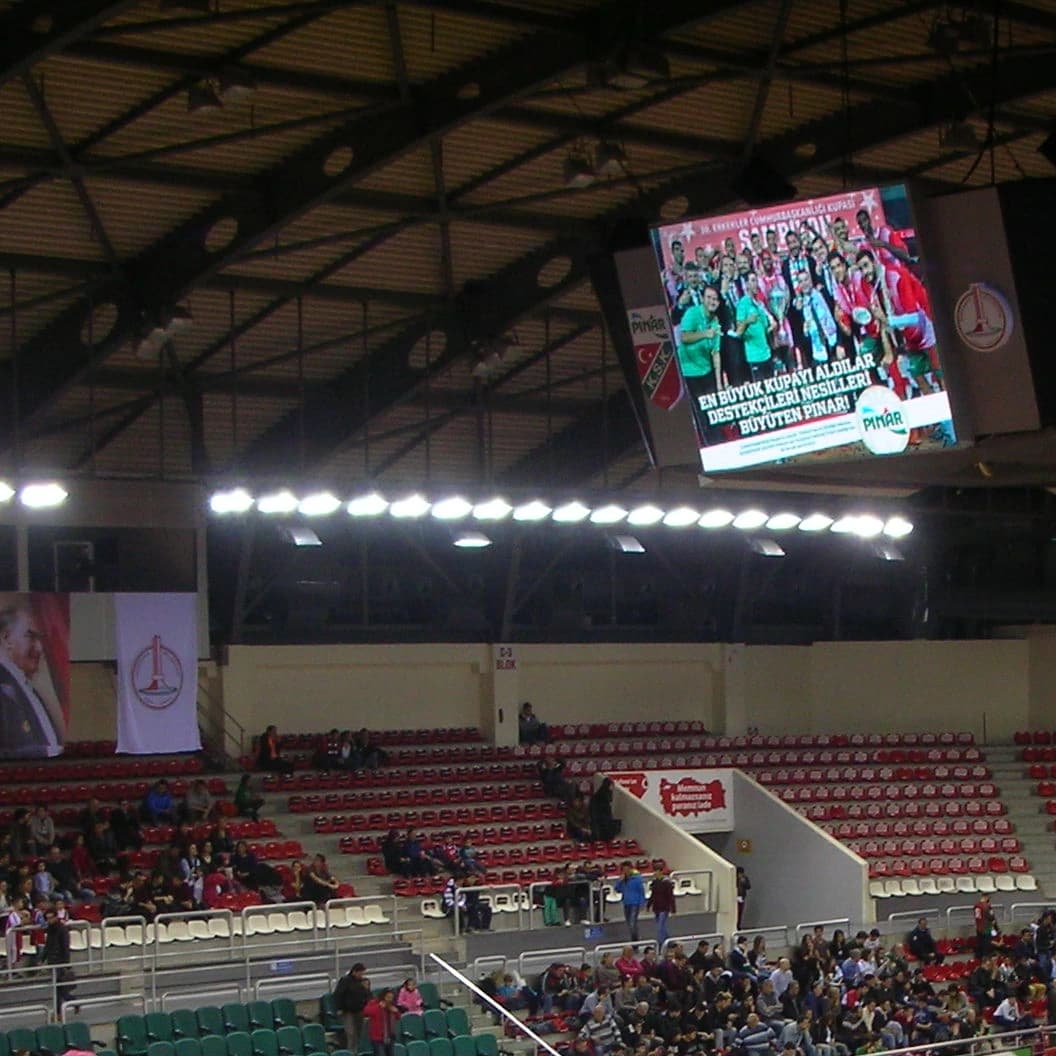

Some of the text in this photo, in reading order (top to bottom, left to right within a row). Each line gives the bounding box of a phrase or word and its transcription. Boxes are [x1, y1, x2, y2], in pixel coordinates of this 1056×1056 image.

[698, 353, 876, 412] EN BÜYÜK KUPAYI ALDILAR
[707, 371, 872, 426] DESTEKÇİLERİ NESİLLERİ
[739, 409, 803, 436] BÜYÜTEN
[863, 411, 905, 431] PINAR
